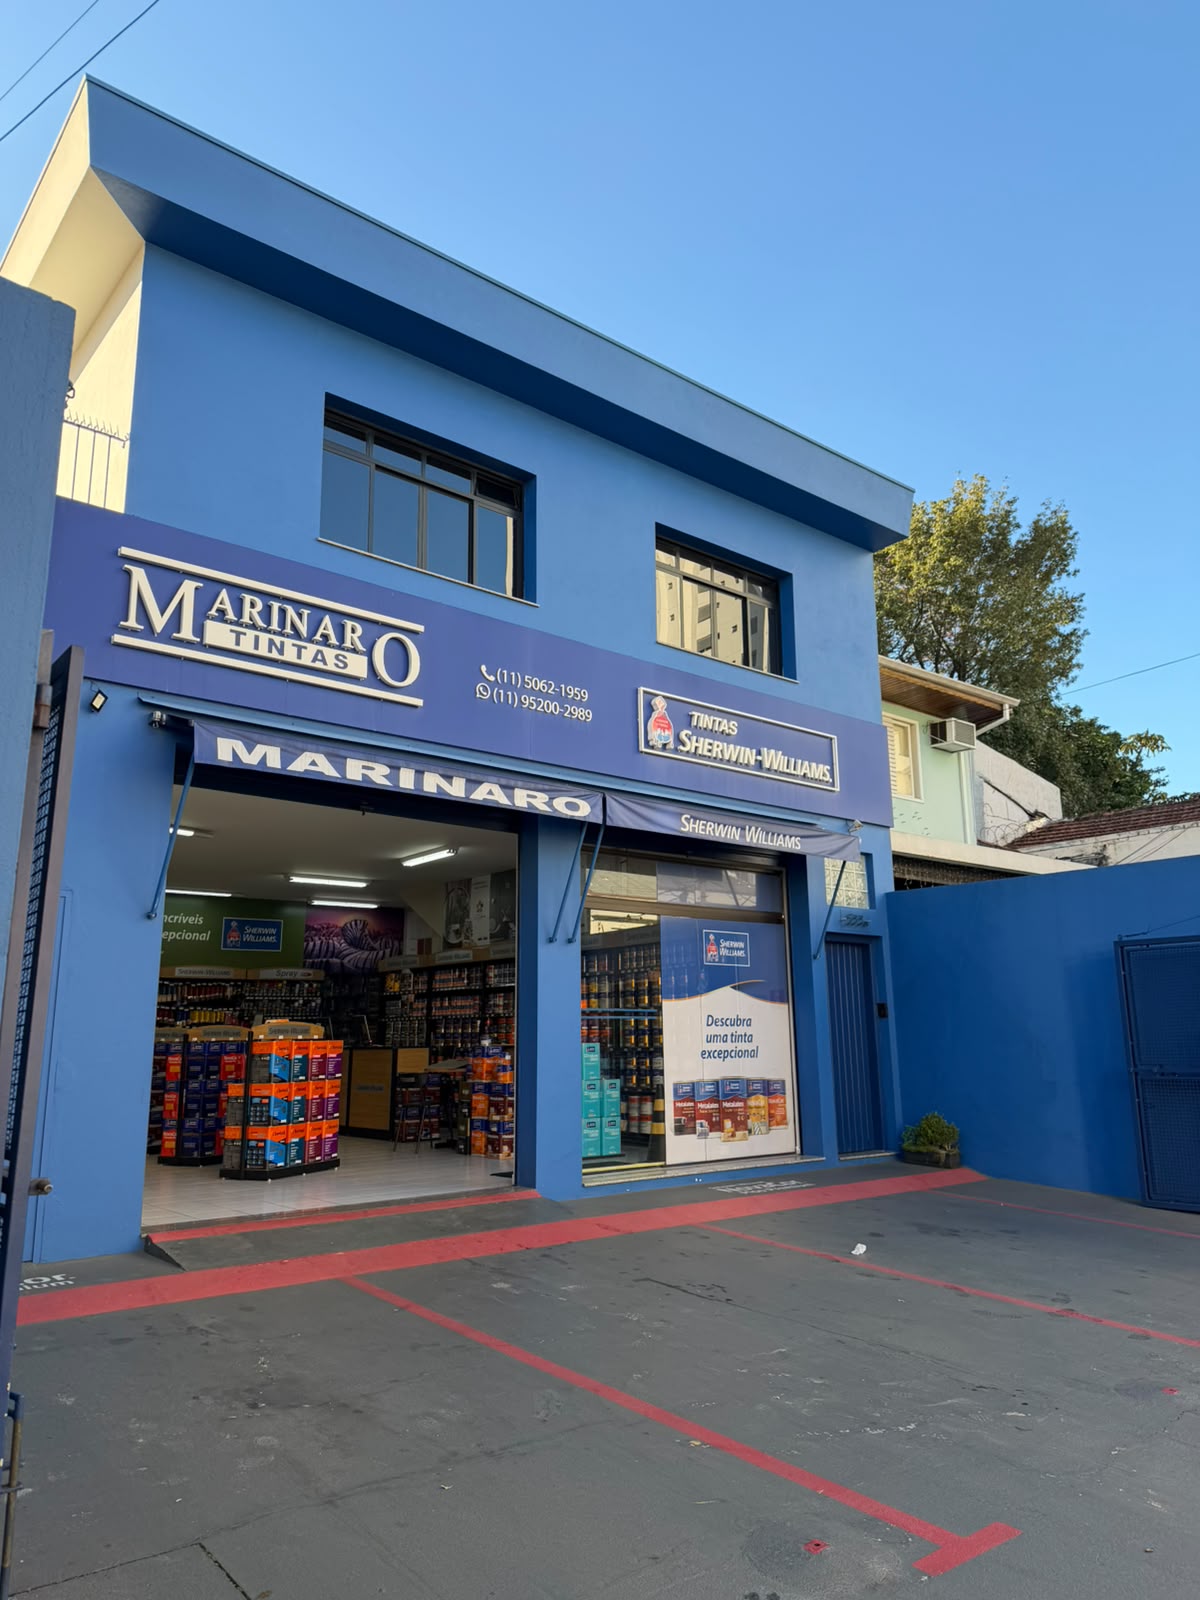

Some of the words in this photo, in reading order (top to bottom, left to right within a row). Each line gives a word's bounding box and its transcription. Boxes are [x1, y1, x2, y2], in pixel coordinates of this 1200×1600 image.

[119, 564, 420, 688] MARINARO
[230, 629, 349, 670] TINTAS
[496, 668, 521, 689] (11)
[524, 675, 589, 702] 5062-1959
[493, 687, 518, 709] (11)
[521, 695, 593, 722] 95200-2989
[689, 711, 738, 736] TINTAS
[216, 737, 592, 818] MARINARO
[680, 814, 741, 841] SHERWIN
[745, 825, 802, 850] WILLIAMS
[244, 926, 277, 935] SHERWIN
[720, 939, 745, 949] SHERWIN
[275, 969, 298, 979] Spray
[706, 1014, 752, 1027] Descubra
[706, 1034, 728, 1044] uma
[730, 1031, 753, 1044] tinta
[700, 1045, 759, 1062] excepcional
